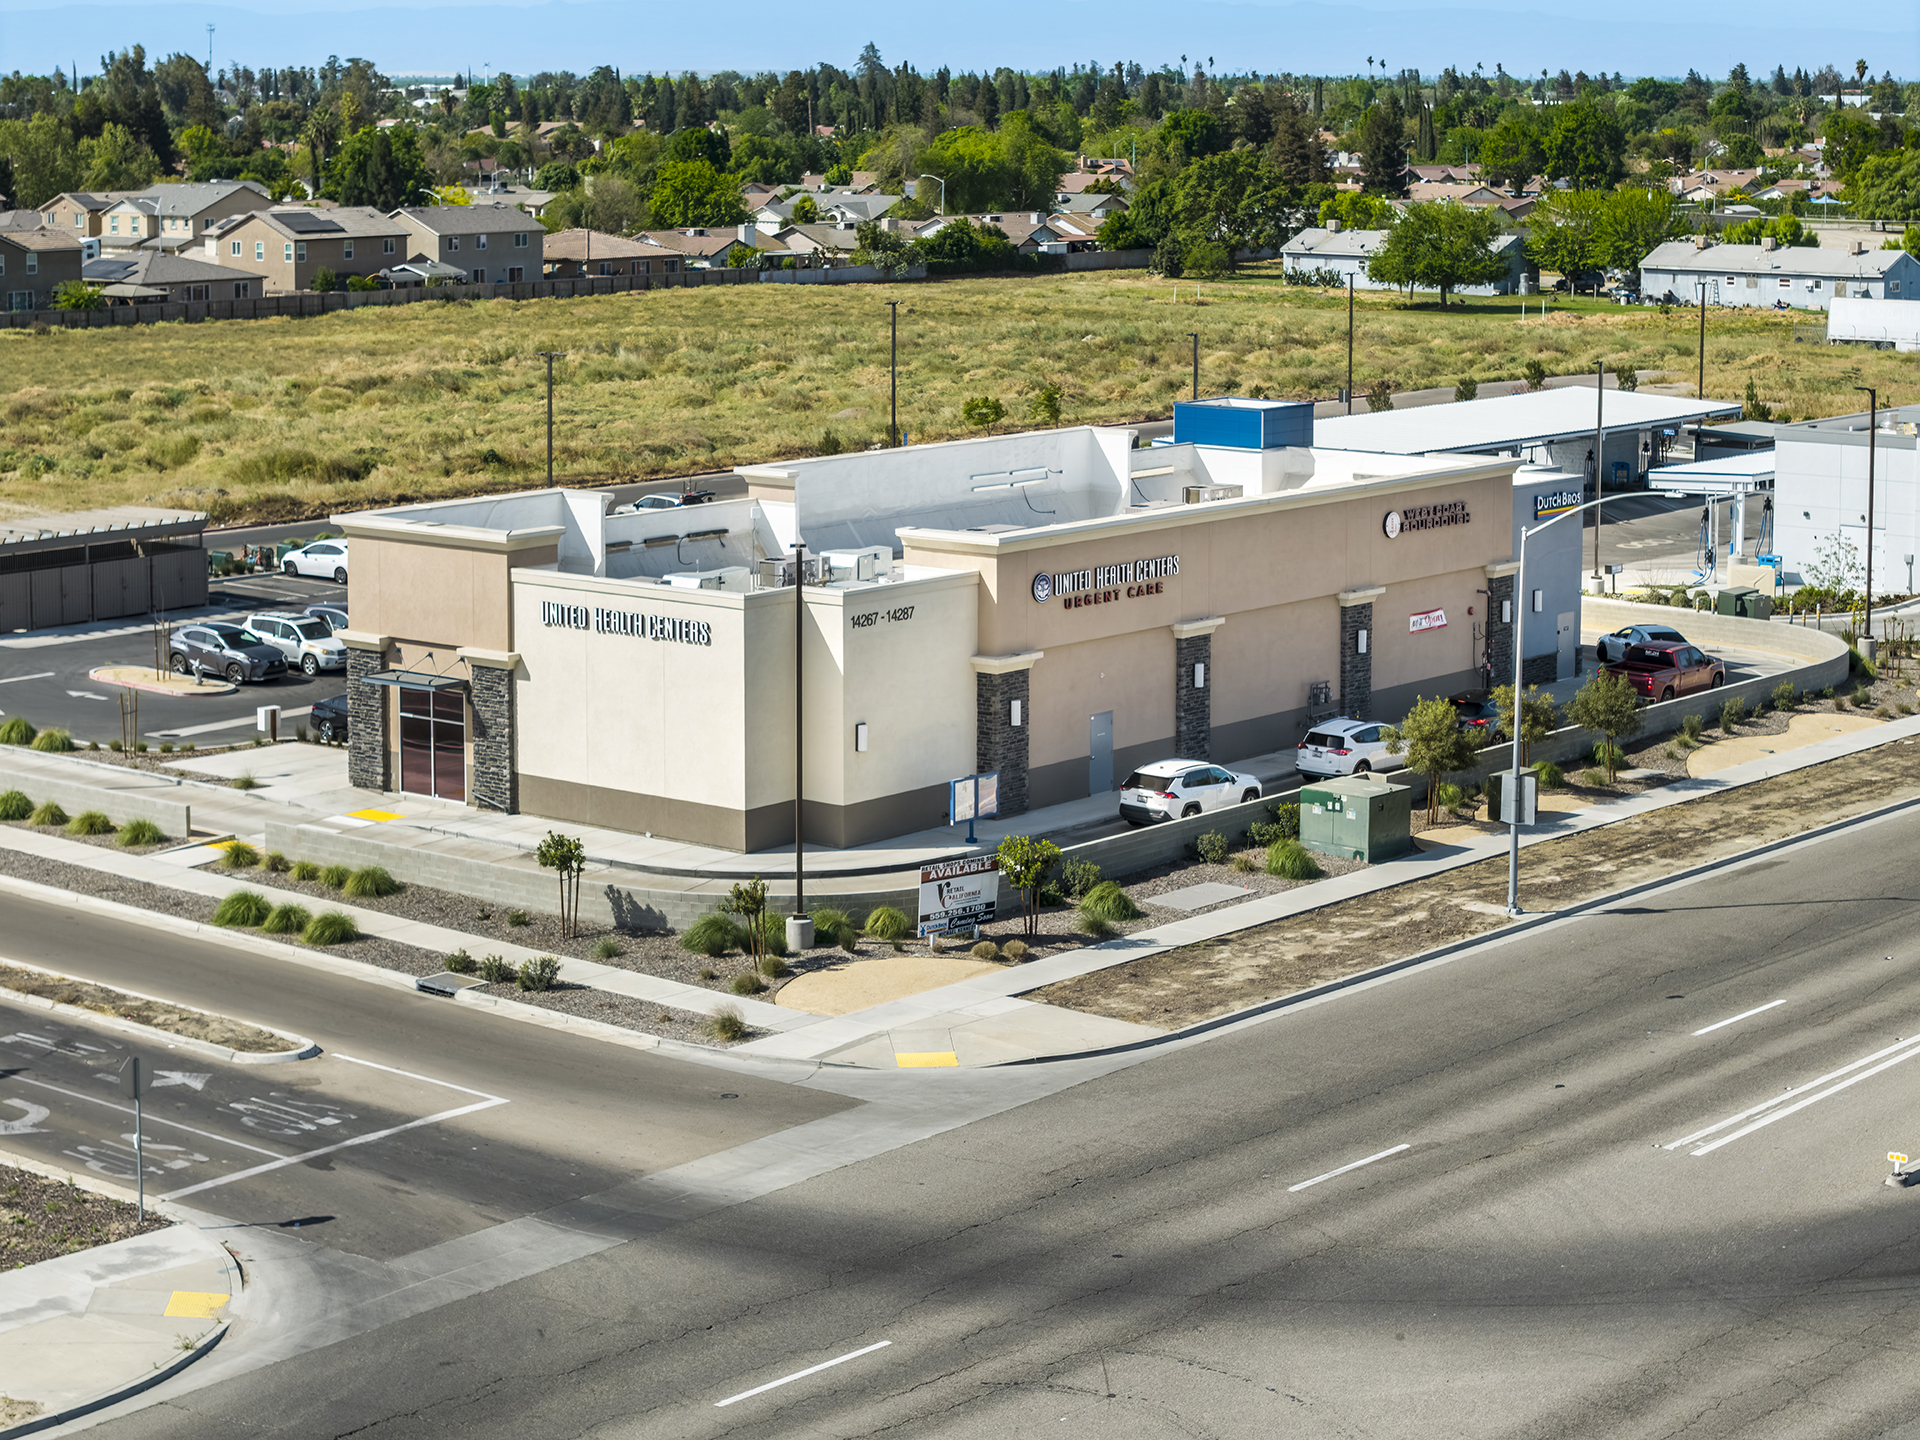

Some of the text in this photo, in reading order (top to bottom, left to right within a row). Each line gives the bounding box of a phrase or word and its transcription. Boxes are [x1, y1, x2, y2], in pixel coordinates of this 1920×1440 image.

[1053, 555, 1180, 597] UNITED HEALTH CENTERS
[1064, 582, 1164, 610] URGENT CARE
[540, 600, 711, 645] UNITED HEALTH CENTERS
[850, 611, 879, 629] 14267
[886, 605, 915, 623] 14287
[929, 862, 991, 880] AVAILABLE
[942, 861, 961, 869] SHOPS
[962, 857, 984, 865] COMING
[946, 885, 965, 894] RETAIL
